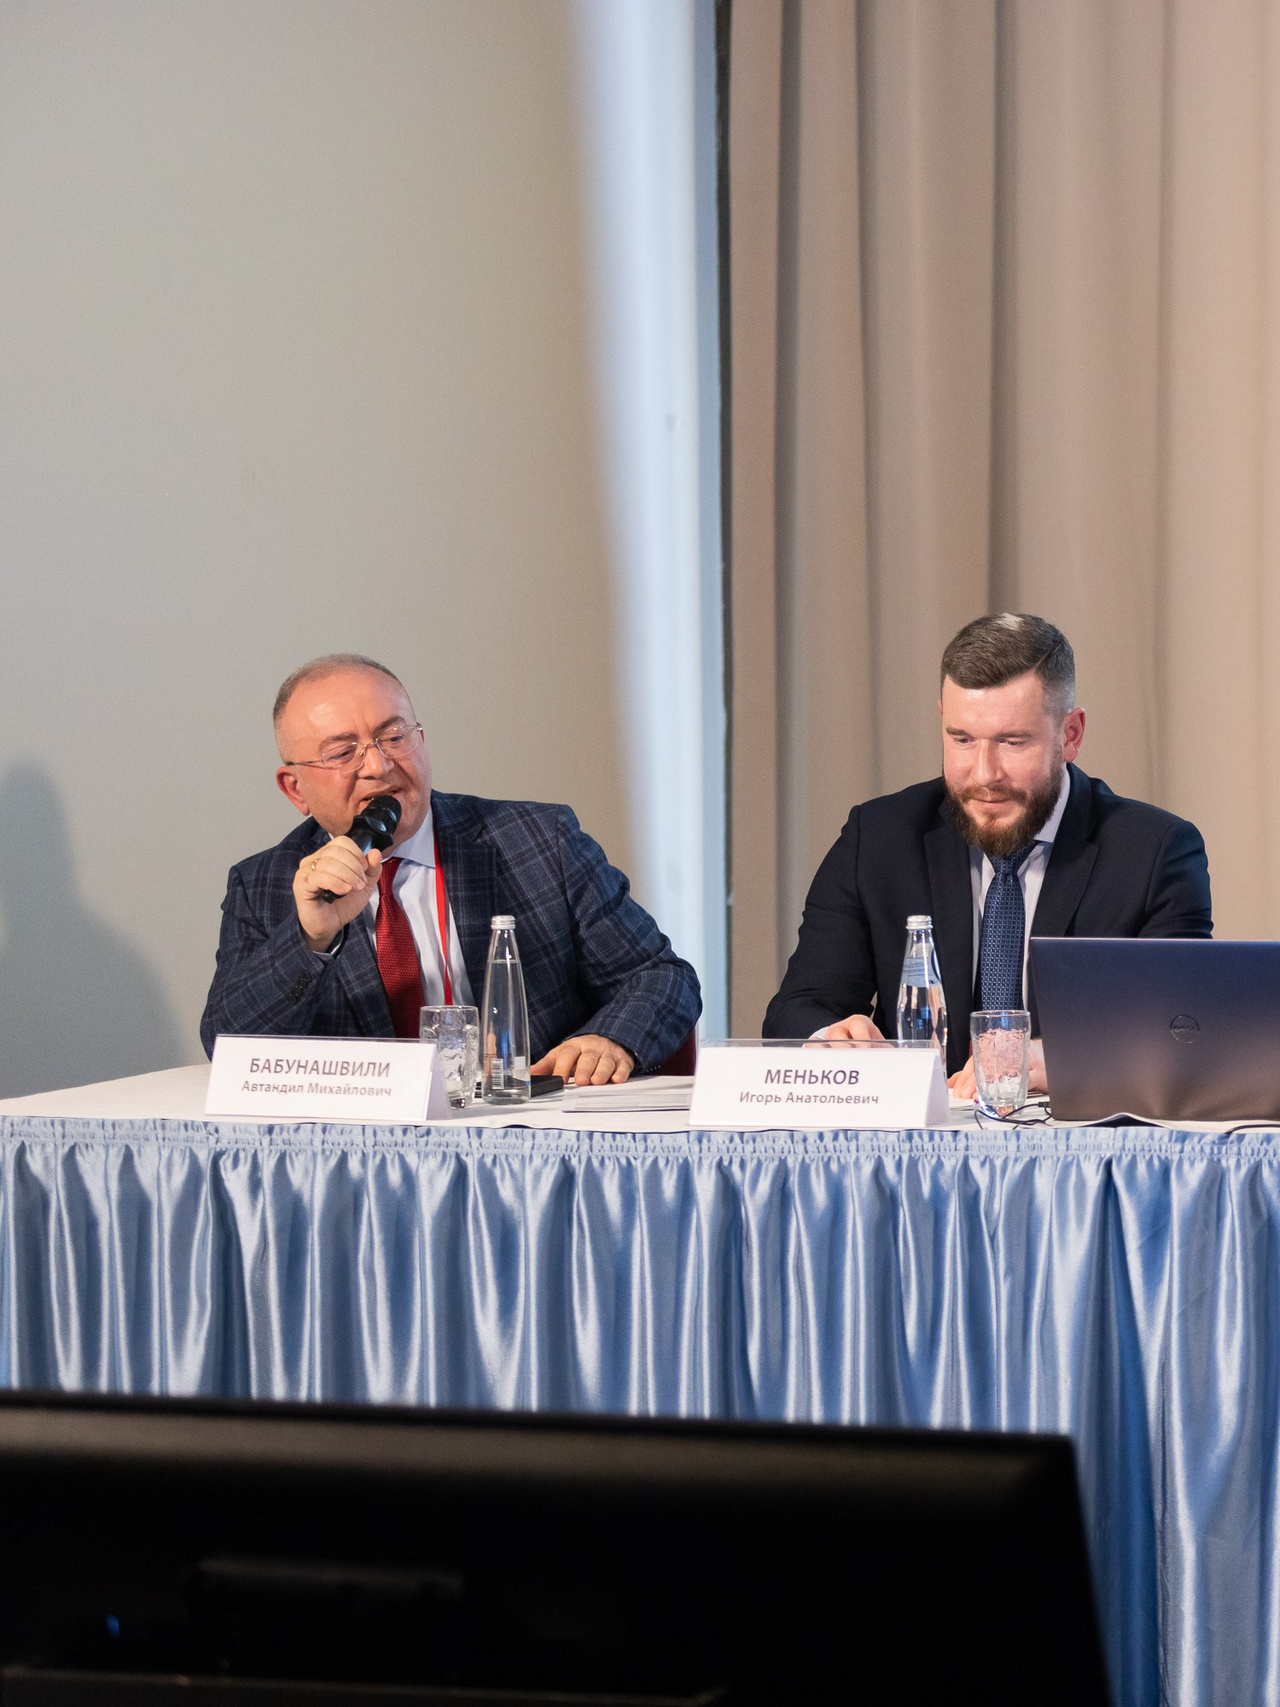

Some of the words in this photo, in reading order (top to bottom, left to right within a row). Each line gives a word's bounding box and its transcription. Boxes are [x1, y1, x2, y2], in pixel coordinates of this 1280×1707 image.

[249, 1058, 391, 1078] БАБУНАШВИЛИ
[764, 1069, 860, 1085] МЕНЬКОВ
[241, 1080, 304, 1094] Автандил
[307, 1082, 392, 1097] Михайлович
[739, 1091, 782, 1107] Игорь
[785, 1091, 879, 1105] Анатольевич
